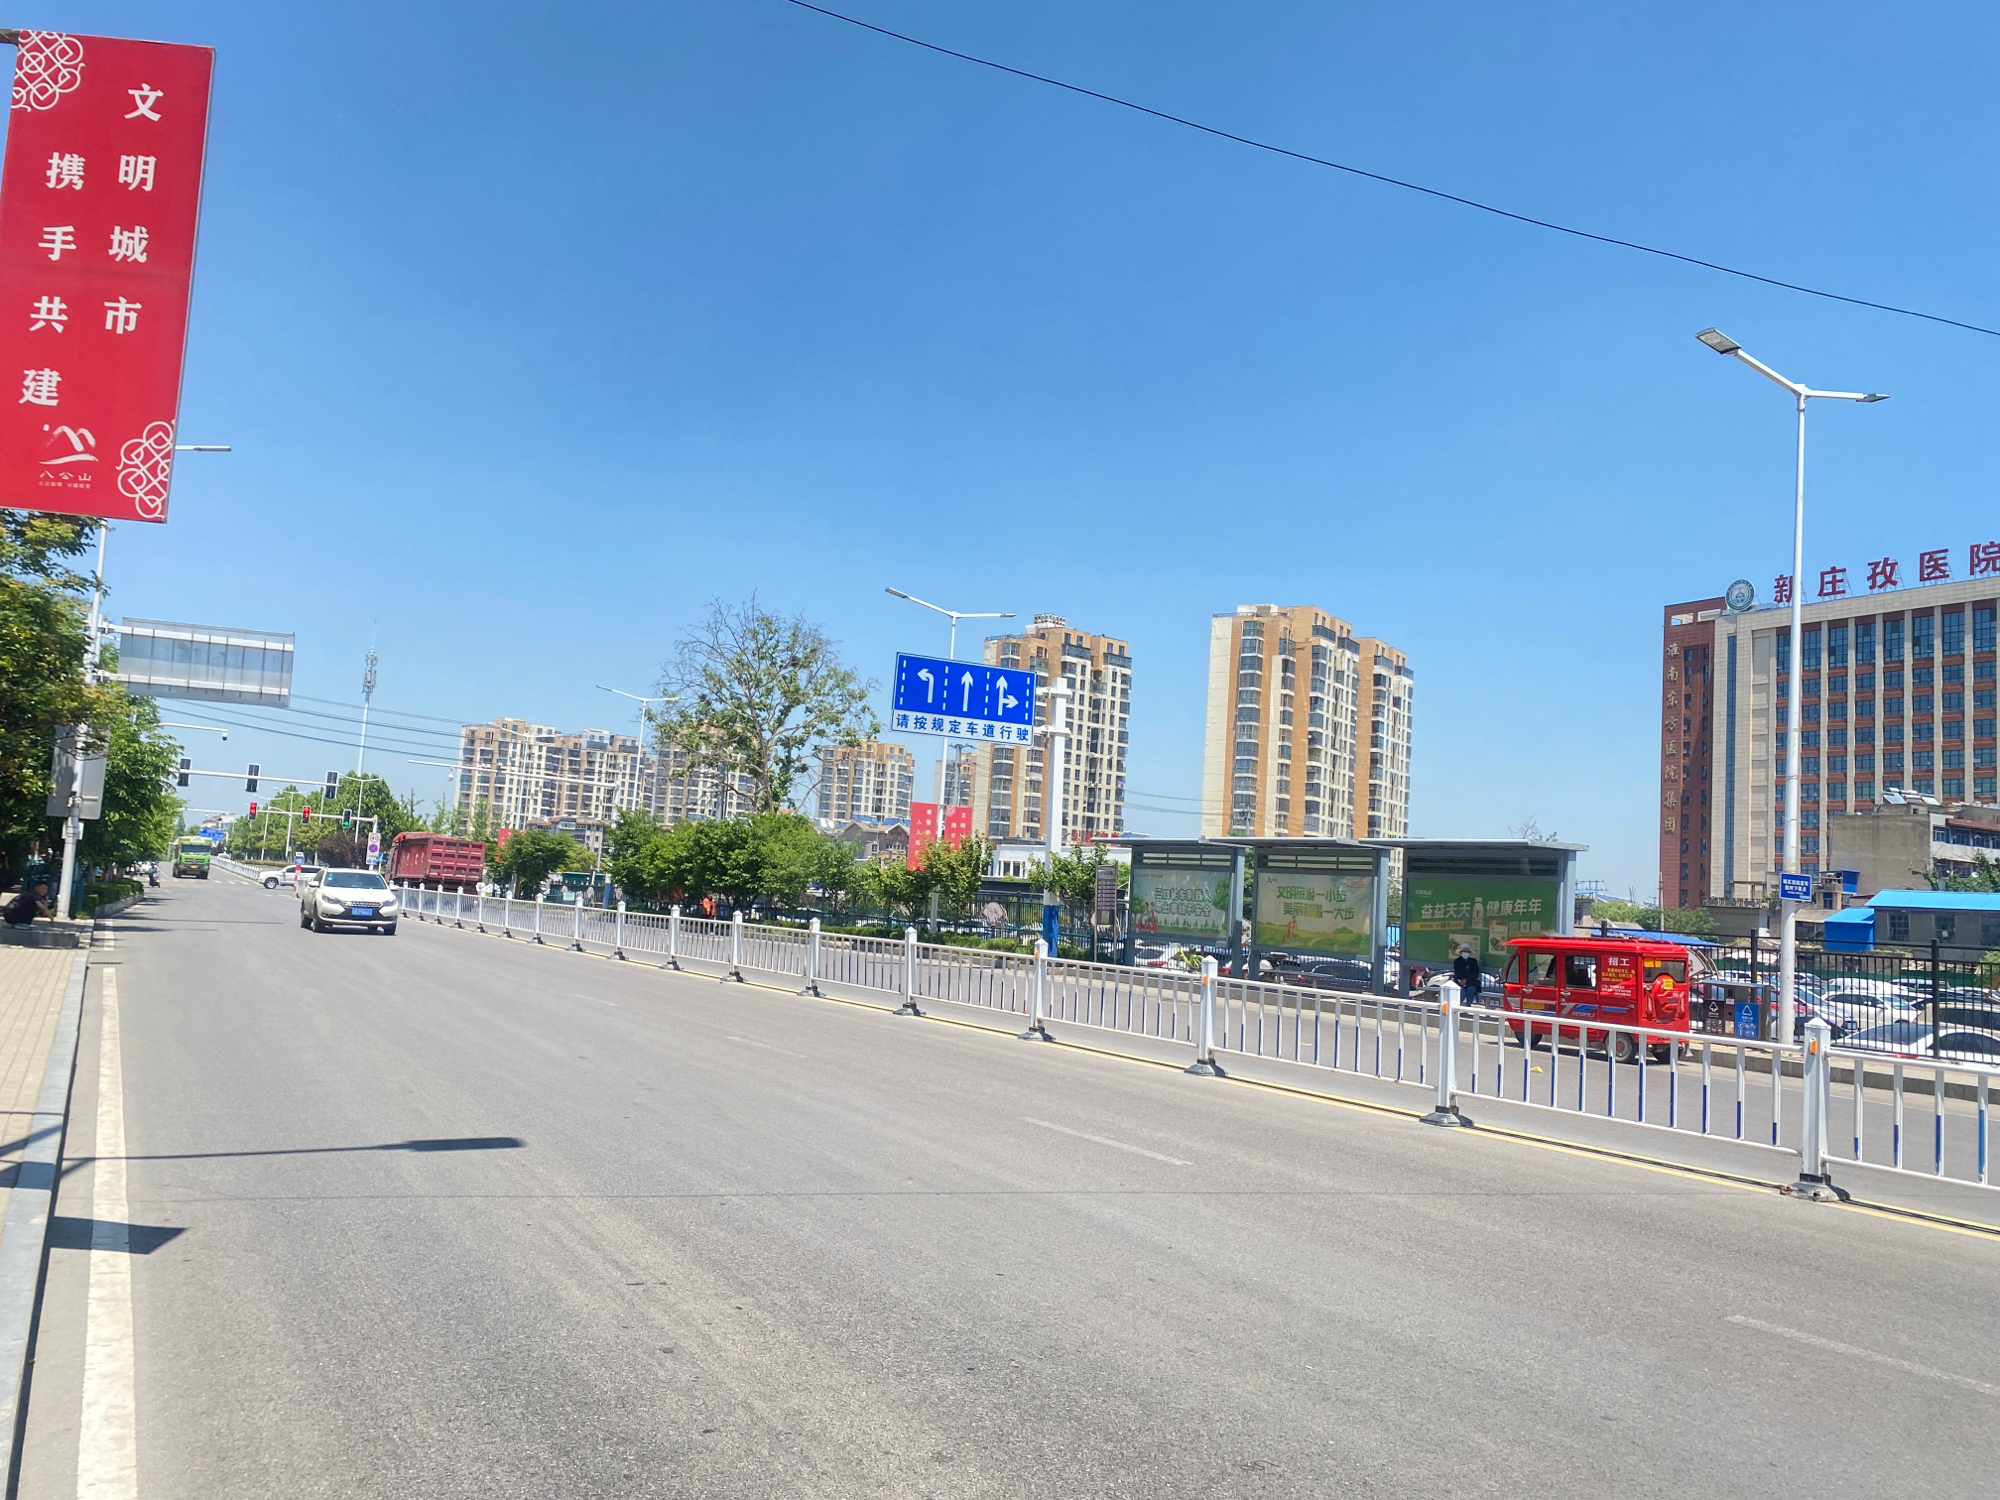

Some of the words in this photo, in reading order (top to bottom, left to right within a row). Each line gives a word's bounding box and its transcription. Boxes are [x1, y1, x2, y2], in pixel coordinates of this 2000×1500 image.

[103, 82, 164, 335] 文明城市
[19, 152, 86, 407] 携手共建
[39, 470, 92, 481] 八公山
[1773, 541, 2000, 604] 新庄孜医院
[895, 713, 1029, 742] 请按规定车道行驶
[1664, 642, 1680, 833] 淮南东方医院集团
[1276, 885, 1348, 903] 文明旅游一小步
[1283, 901, 1355, 920] 美丽和谐一大步
[1421, 902, 1471, 919] 益益天天
[1486, 898, 1543, 917] 健康年年
[1608, 956, 1630, 966] 招工
